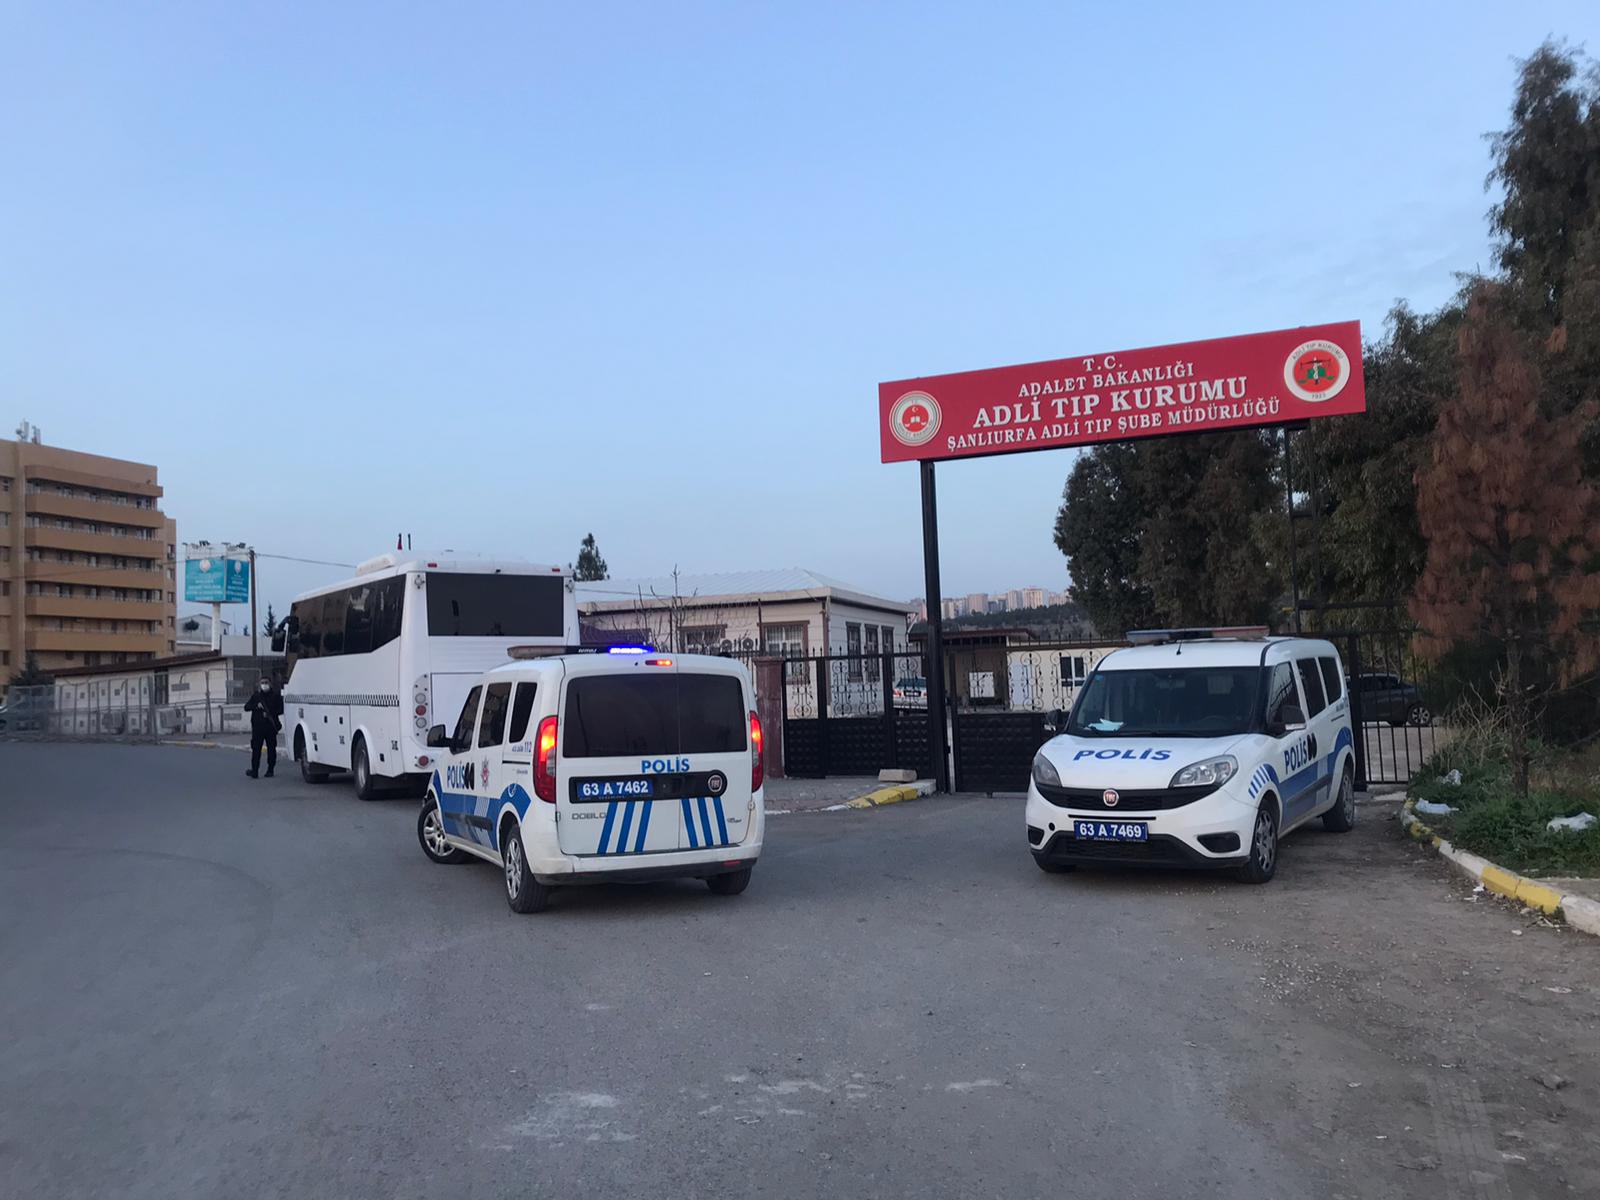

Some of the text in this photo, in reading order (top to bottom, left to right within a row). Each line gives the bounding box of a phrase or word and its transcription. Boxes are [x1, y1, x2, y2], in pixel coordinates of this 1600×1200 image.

[1083, 355, 1123, 372] T.C.
[1018, 361, 1194, 397] ADALET BAKANLIĞI
[972, 376, 1248, 429] ADLİ TIP KURUMU
[947, 427, 1036, 452] ŞANLIURFA
[1041, 419, 1080, 440] ADLİ
[1084, 418, 1113, 435] TIP
[1118, 412, 1163, 435] ŞUBE
[1168, 396, 1280, 425] MÜDÜRLÜĞÜ
[1073, 748, 1172, 761] POLİS
[1284, 738, 1307, 775] POLİS
[641, 756, 690, 774] POLİS
[582, 780, 649, 796] 63 A 7462
[1079, 823, 1142, 838] 63 A 7469
